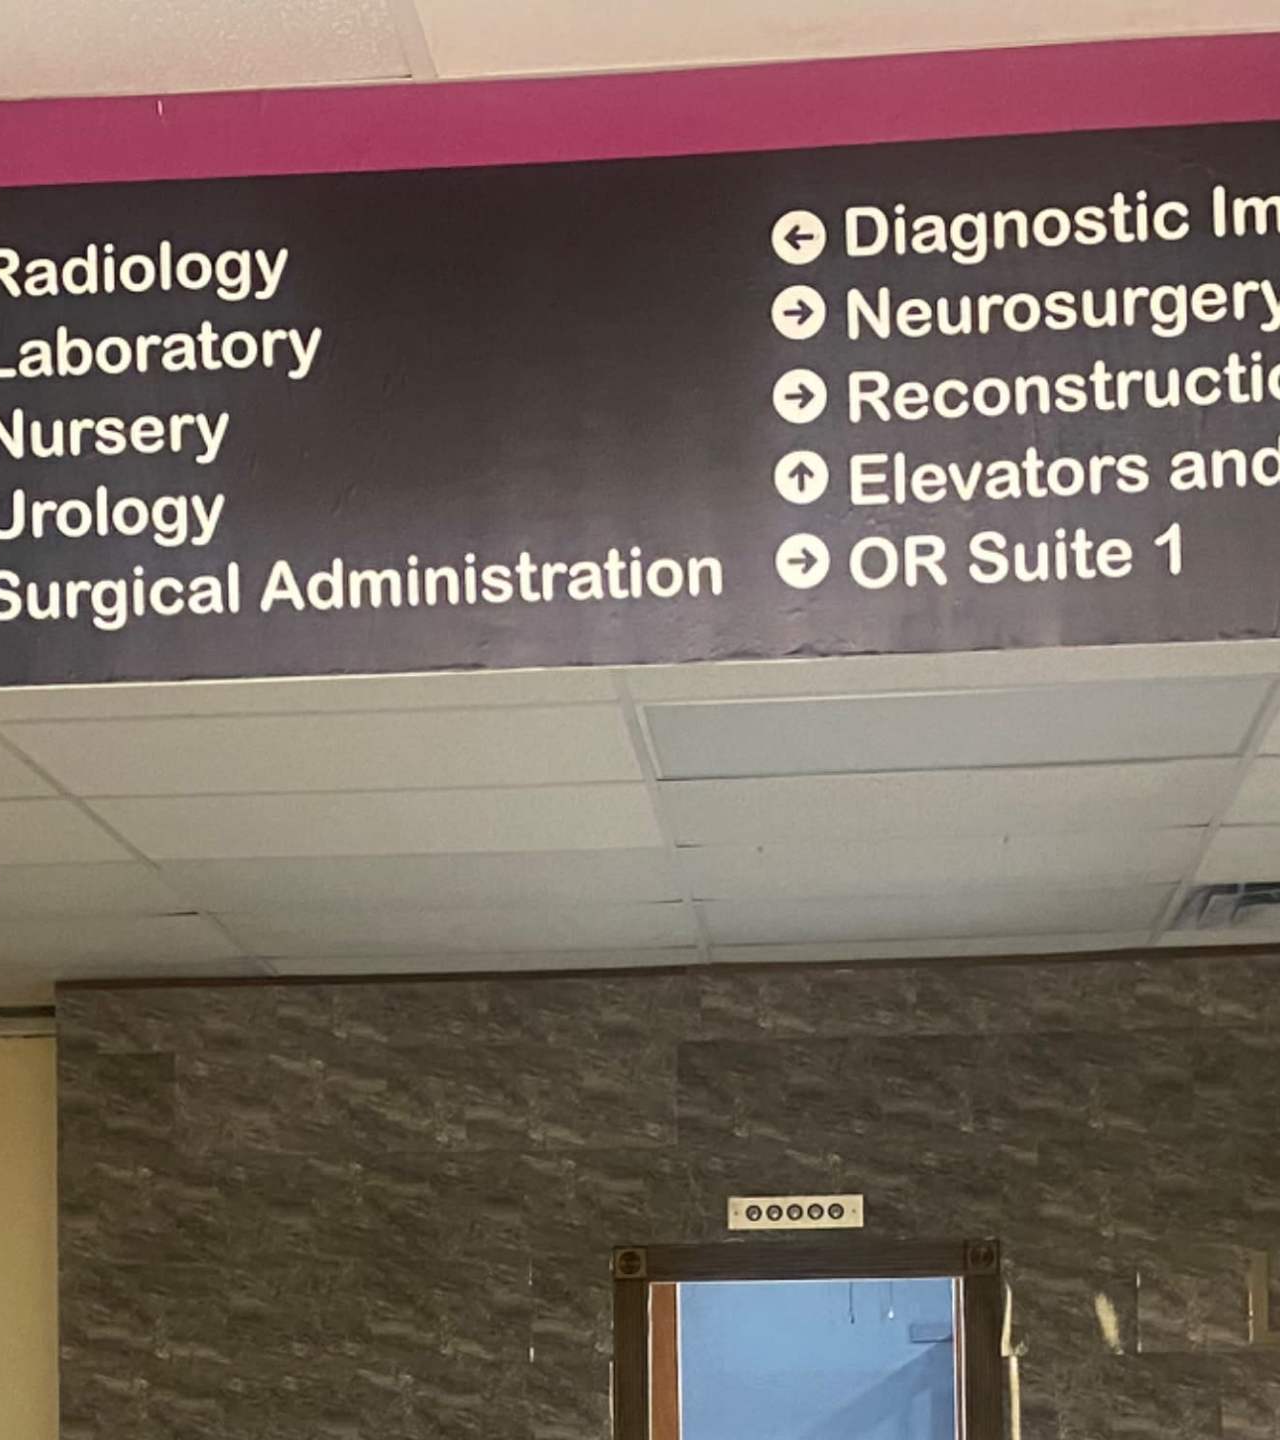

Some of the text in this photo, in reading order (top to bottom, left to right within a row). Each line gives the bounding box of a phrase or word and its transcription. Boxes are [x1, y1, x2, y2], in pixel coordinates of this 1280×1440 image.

[845, 190, 1190, 265] Diagnostic
[849, 444, 1151, 506] Elevators
[260, 545, 724, 614] Administration
[849, 522, 1183, 591] OR Suite 1
